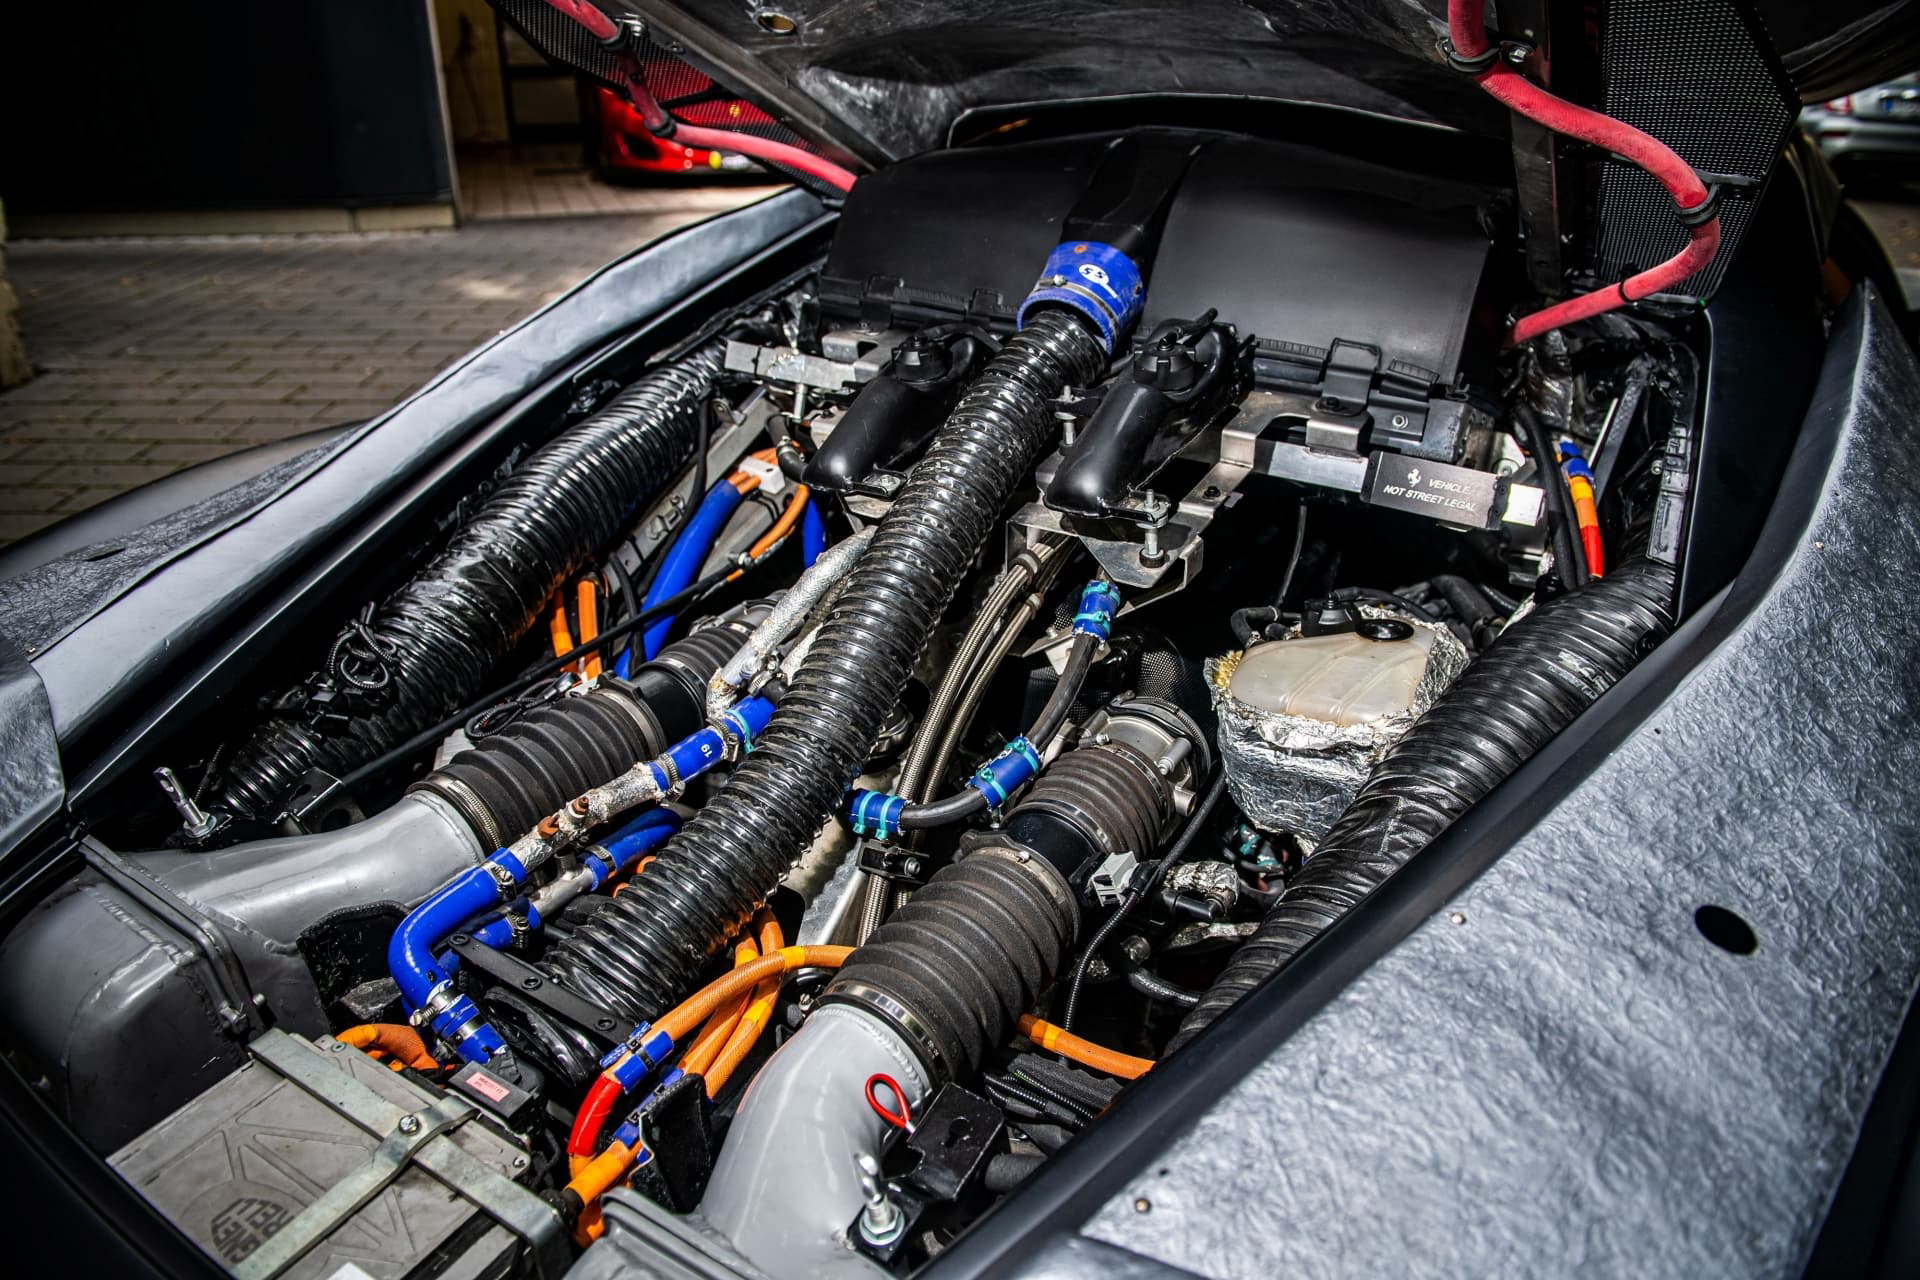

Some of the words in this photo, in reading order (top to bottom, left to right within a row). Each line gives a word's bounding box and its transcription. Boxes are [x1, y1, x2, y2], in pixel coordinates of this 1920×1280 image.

[1429, 479, 1472, 494] VEHICLE
[1383, 485, 1406, 496] NOT
[1405, 490, 1445, 504] STREET
[1445, 498, 1475, 511] LEGAL
